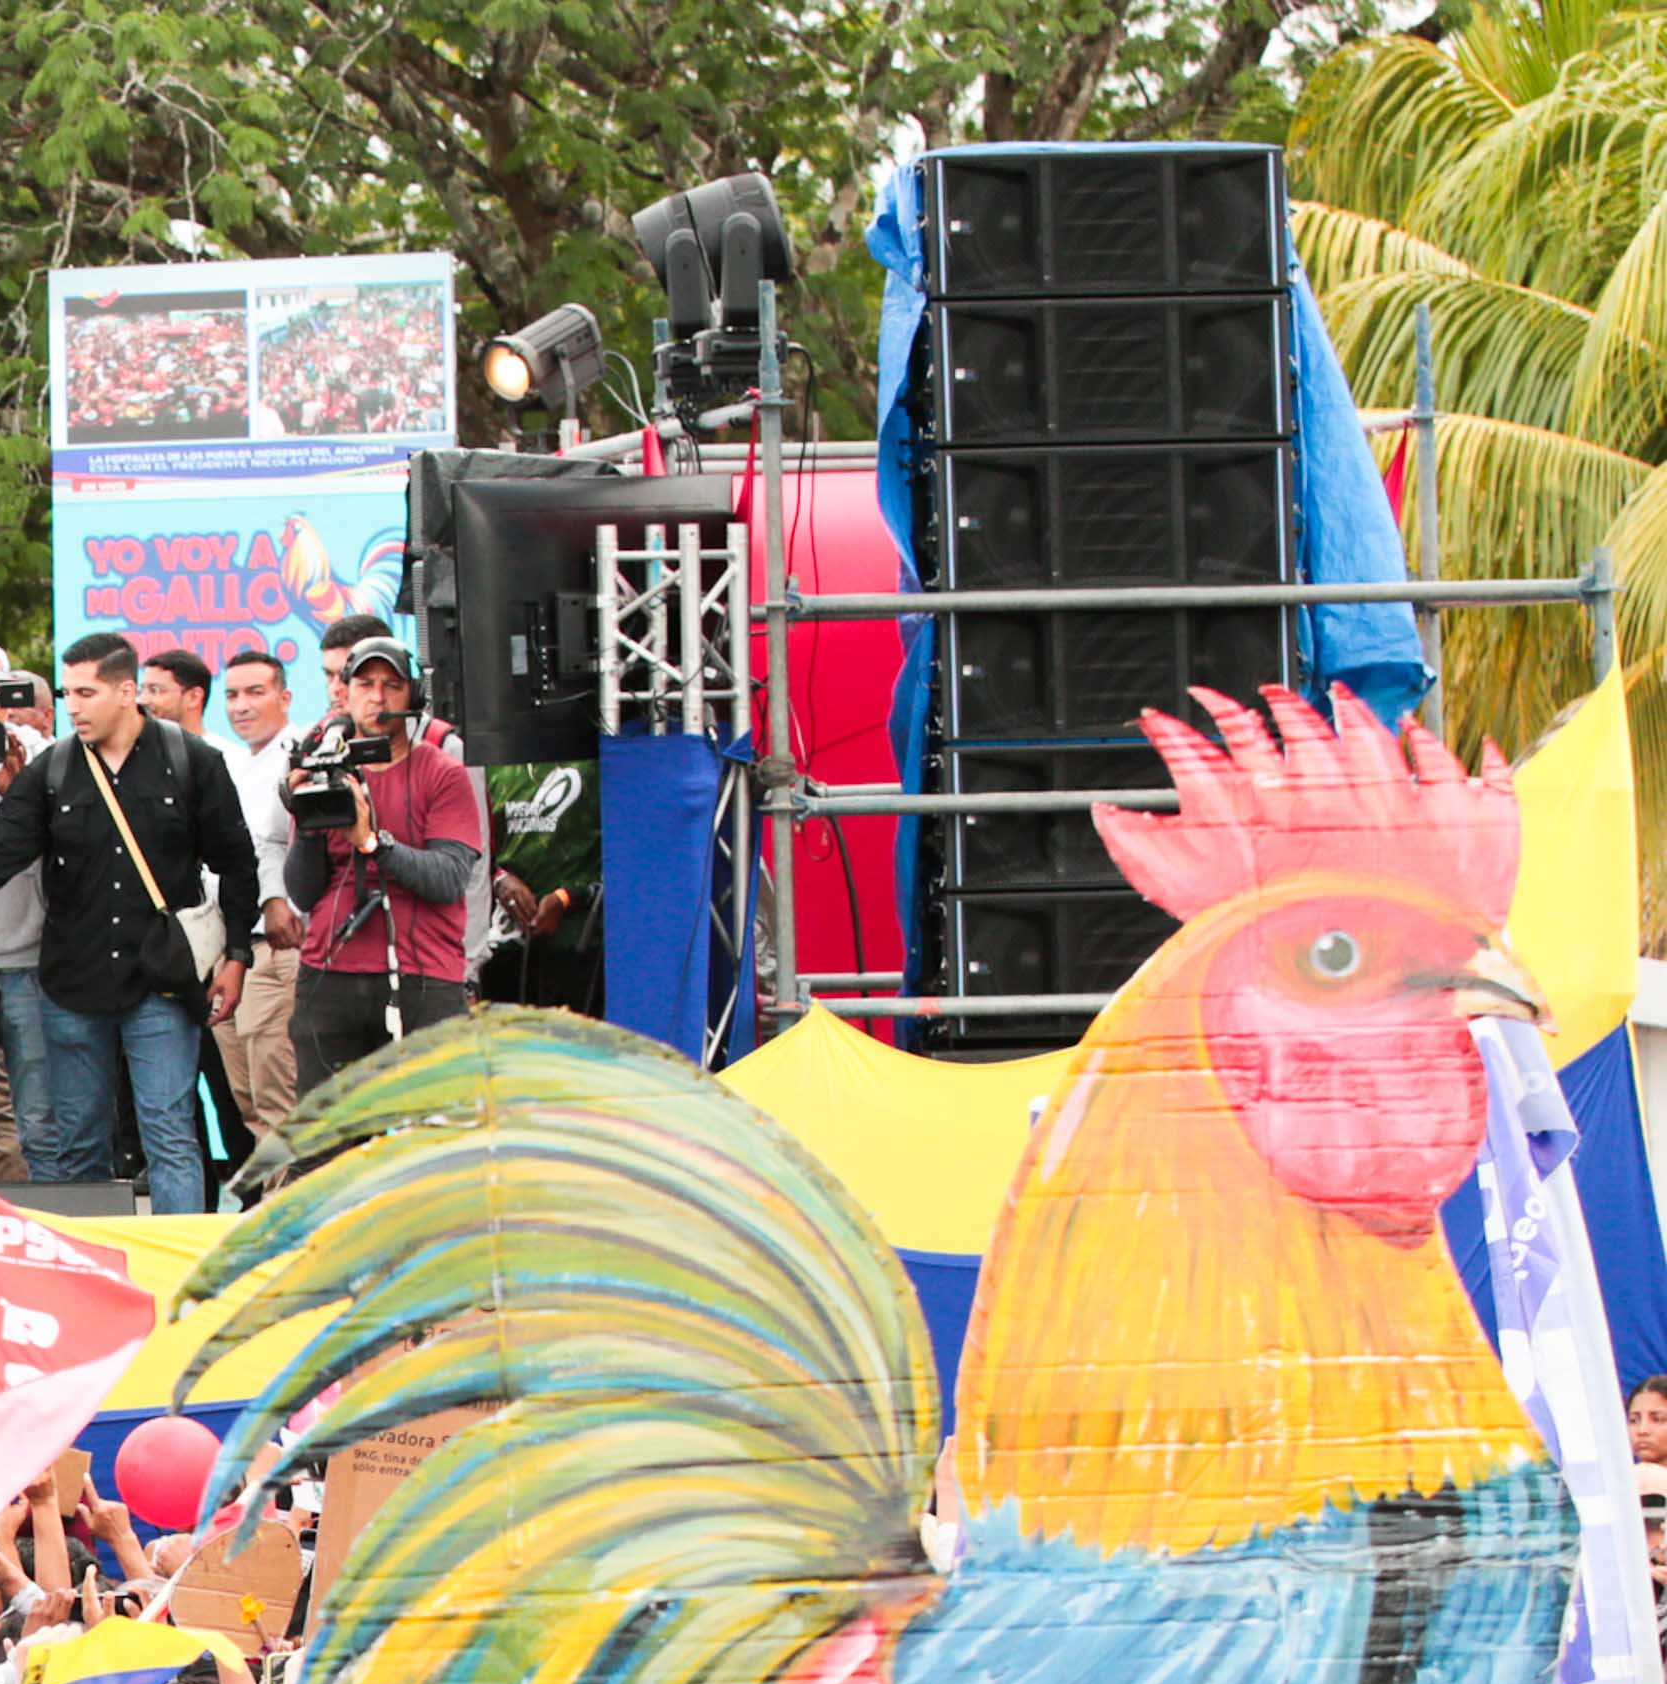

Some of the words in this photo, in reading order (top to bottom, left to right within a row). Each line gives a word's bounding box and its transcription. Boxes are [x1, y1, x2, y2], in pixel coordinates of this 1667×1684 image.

[86, 537, 145, 574] YO
[154, 534, 238, 572] VOY
[247, 533, 279, 570] A
[122, 572, 291, 625] GALLO
[370, 1430, 436, 1449] vadora
